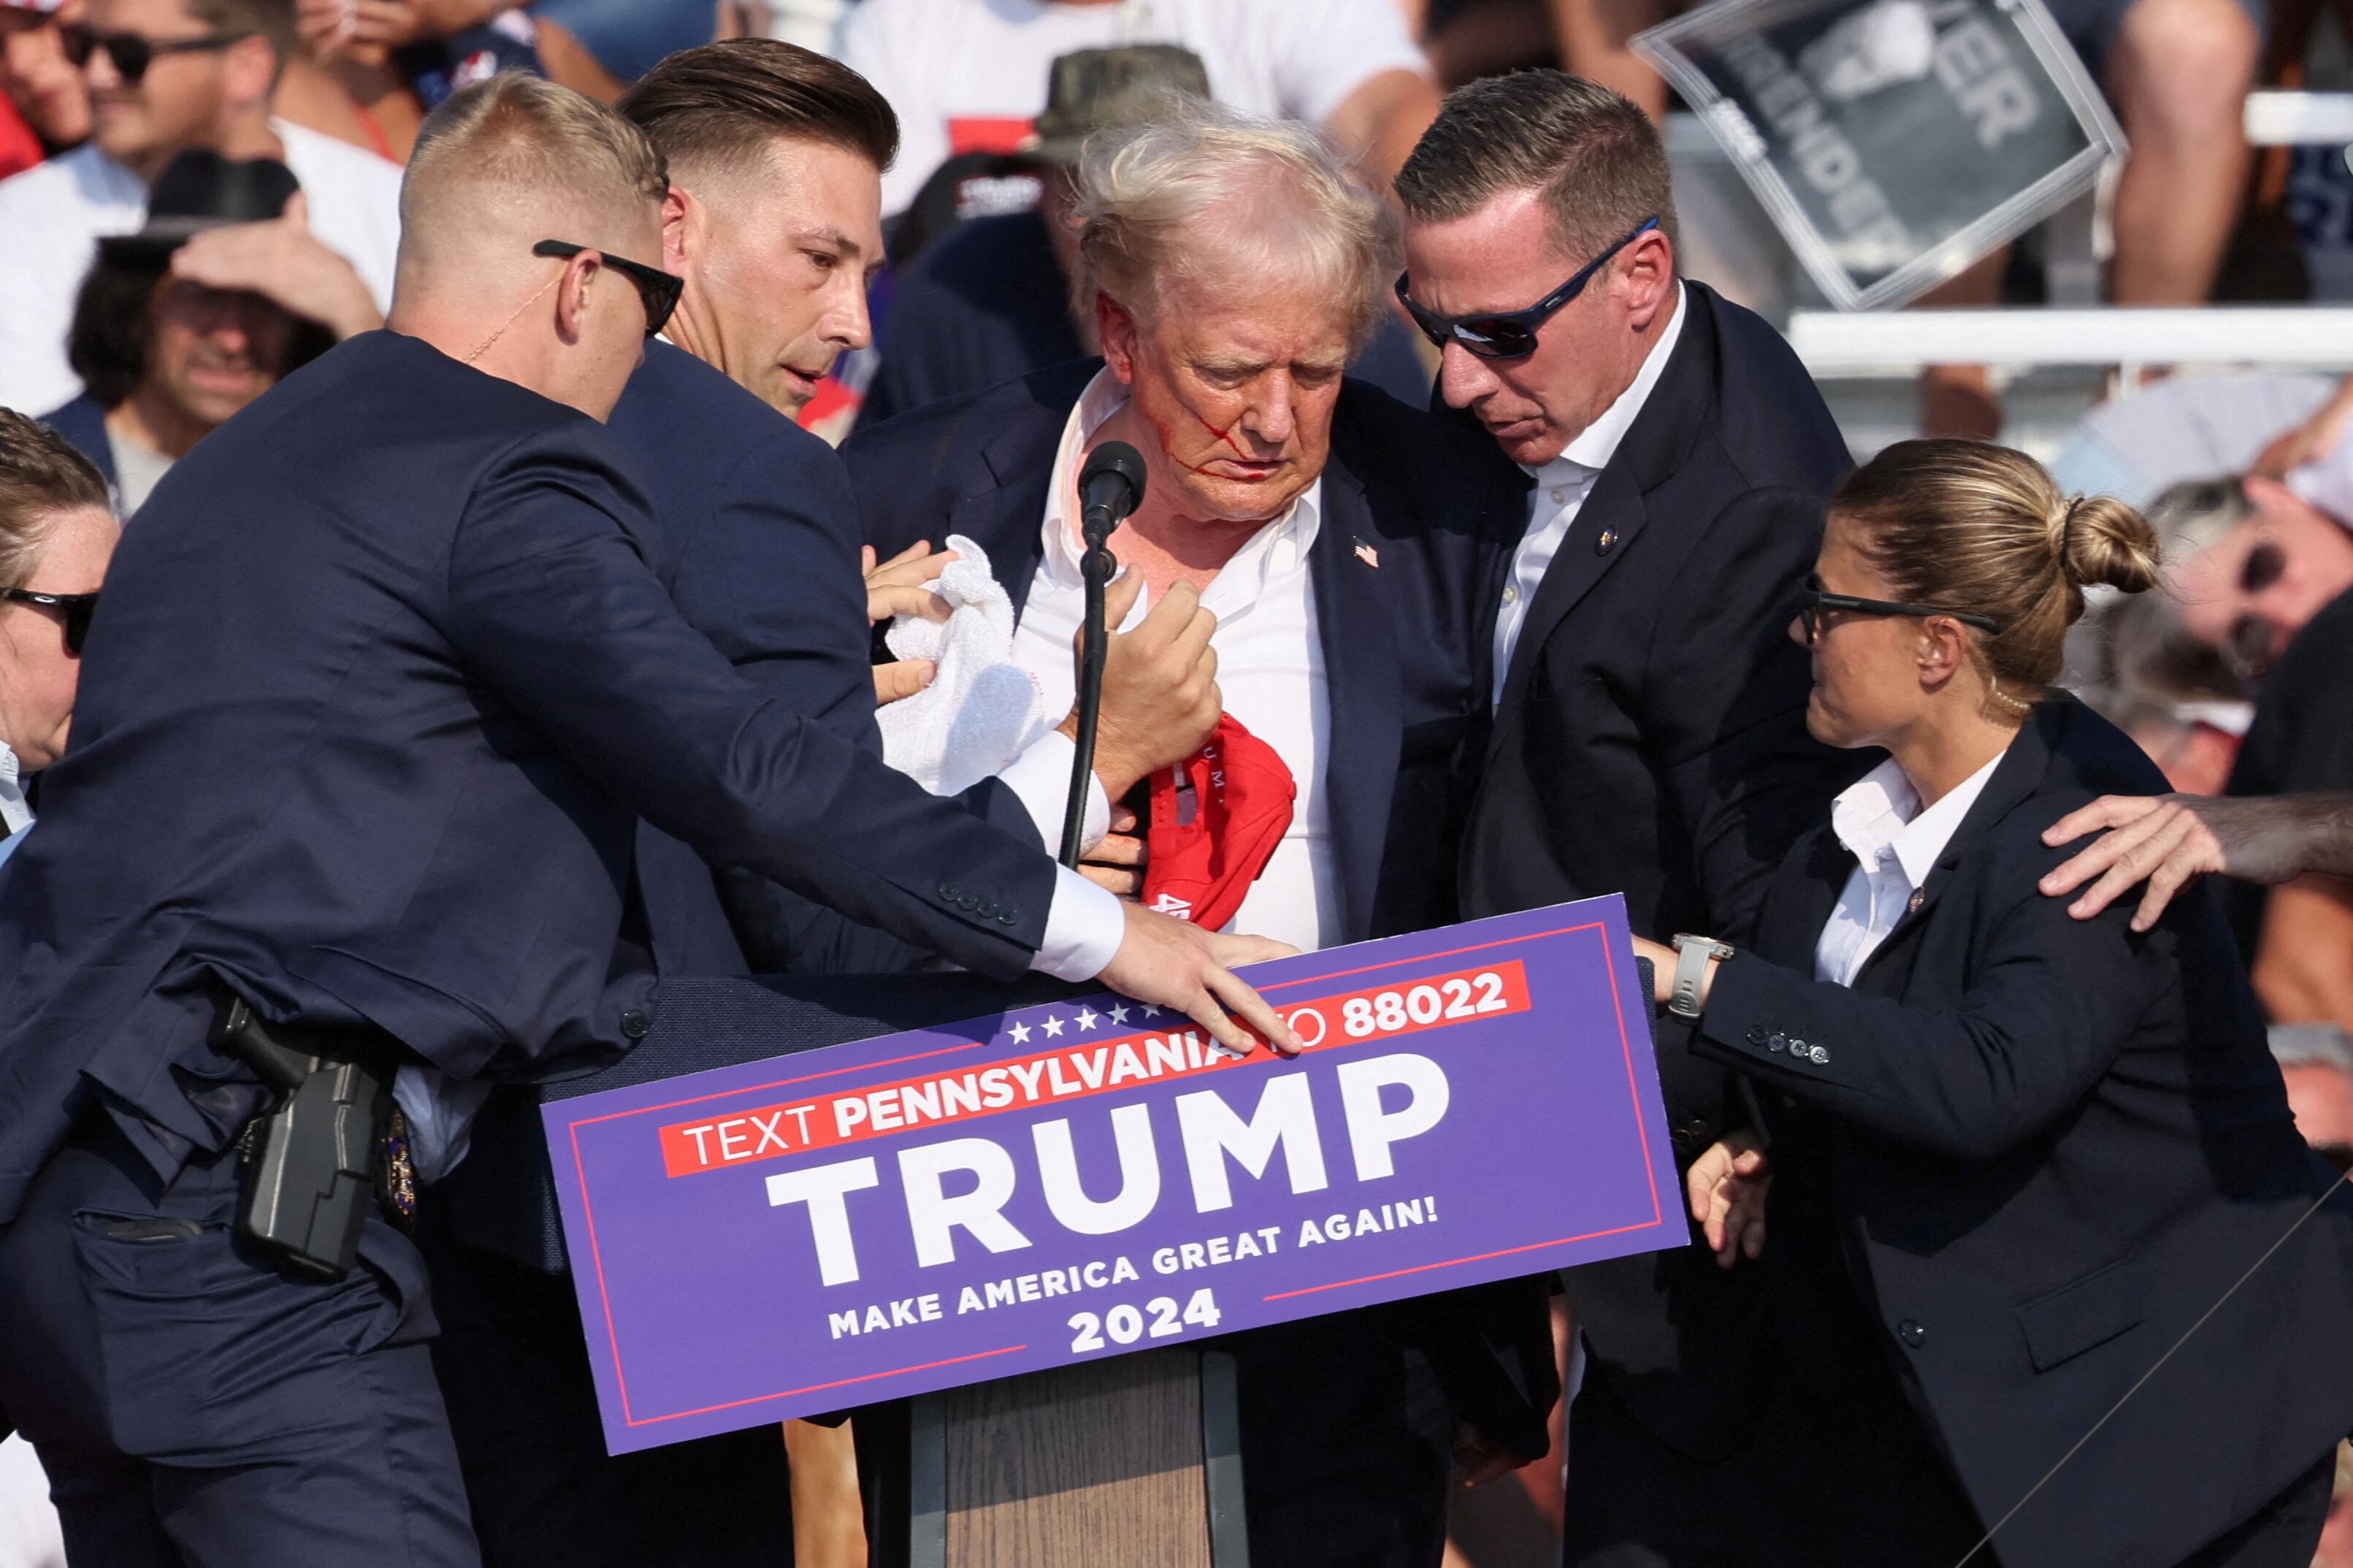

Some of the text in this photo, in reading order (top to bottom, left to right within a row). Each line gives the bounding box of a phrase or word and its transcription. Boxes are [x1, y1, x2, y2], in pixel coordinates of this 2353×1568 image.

[682, 972, 1507, 1165] TEXT PENNSYLVANIA O 88022
[765, 1053, 1450, 1287] TRUMP
[828, 1196, 1438, 1339] MAKE AMERICA GREAT AGAIN!
[1067, 1288, 1222, 1353] 2024
